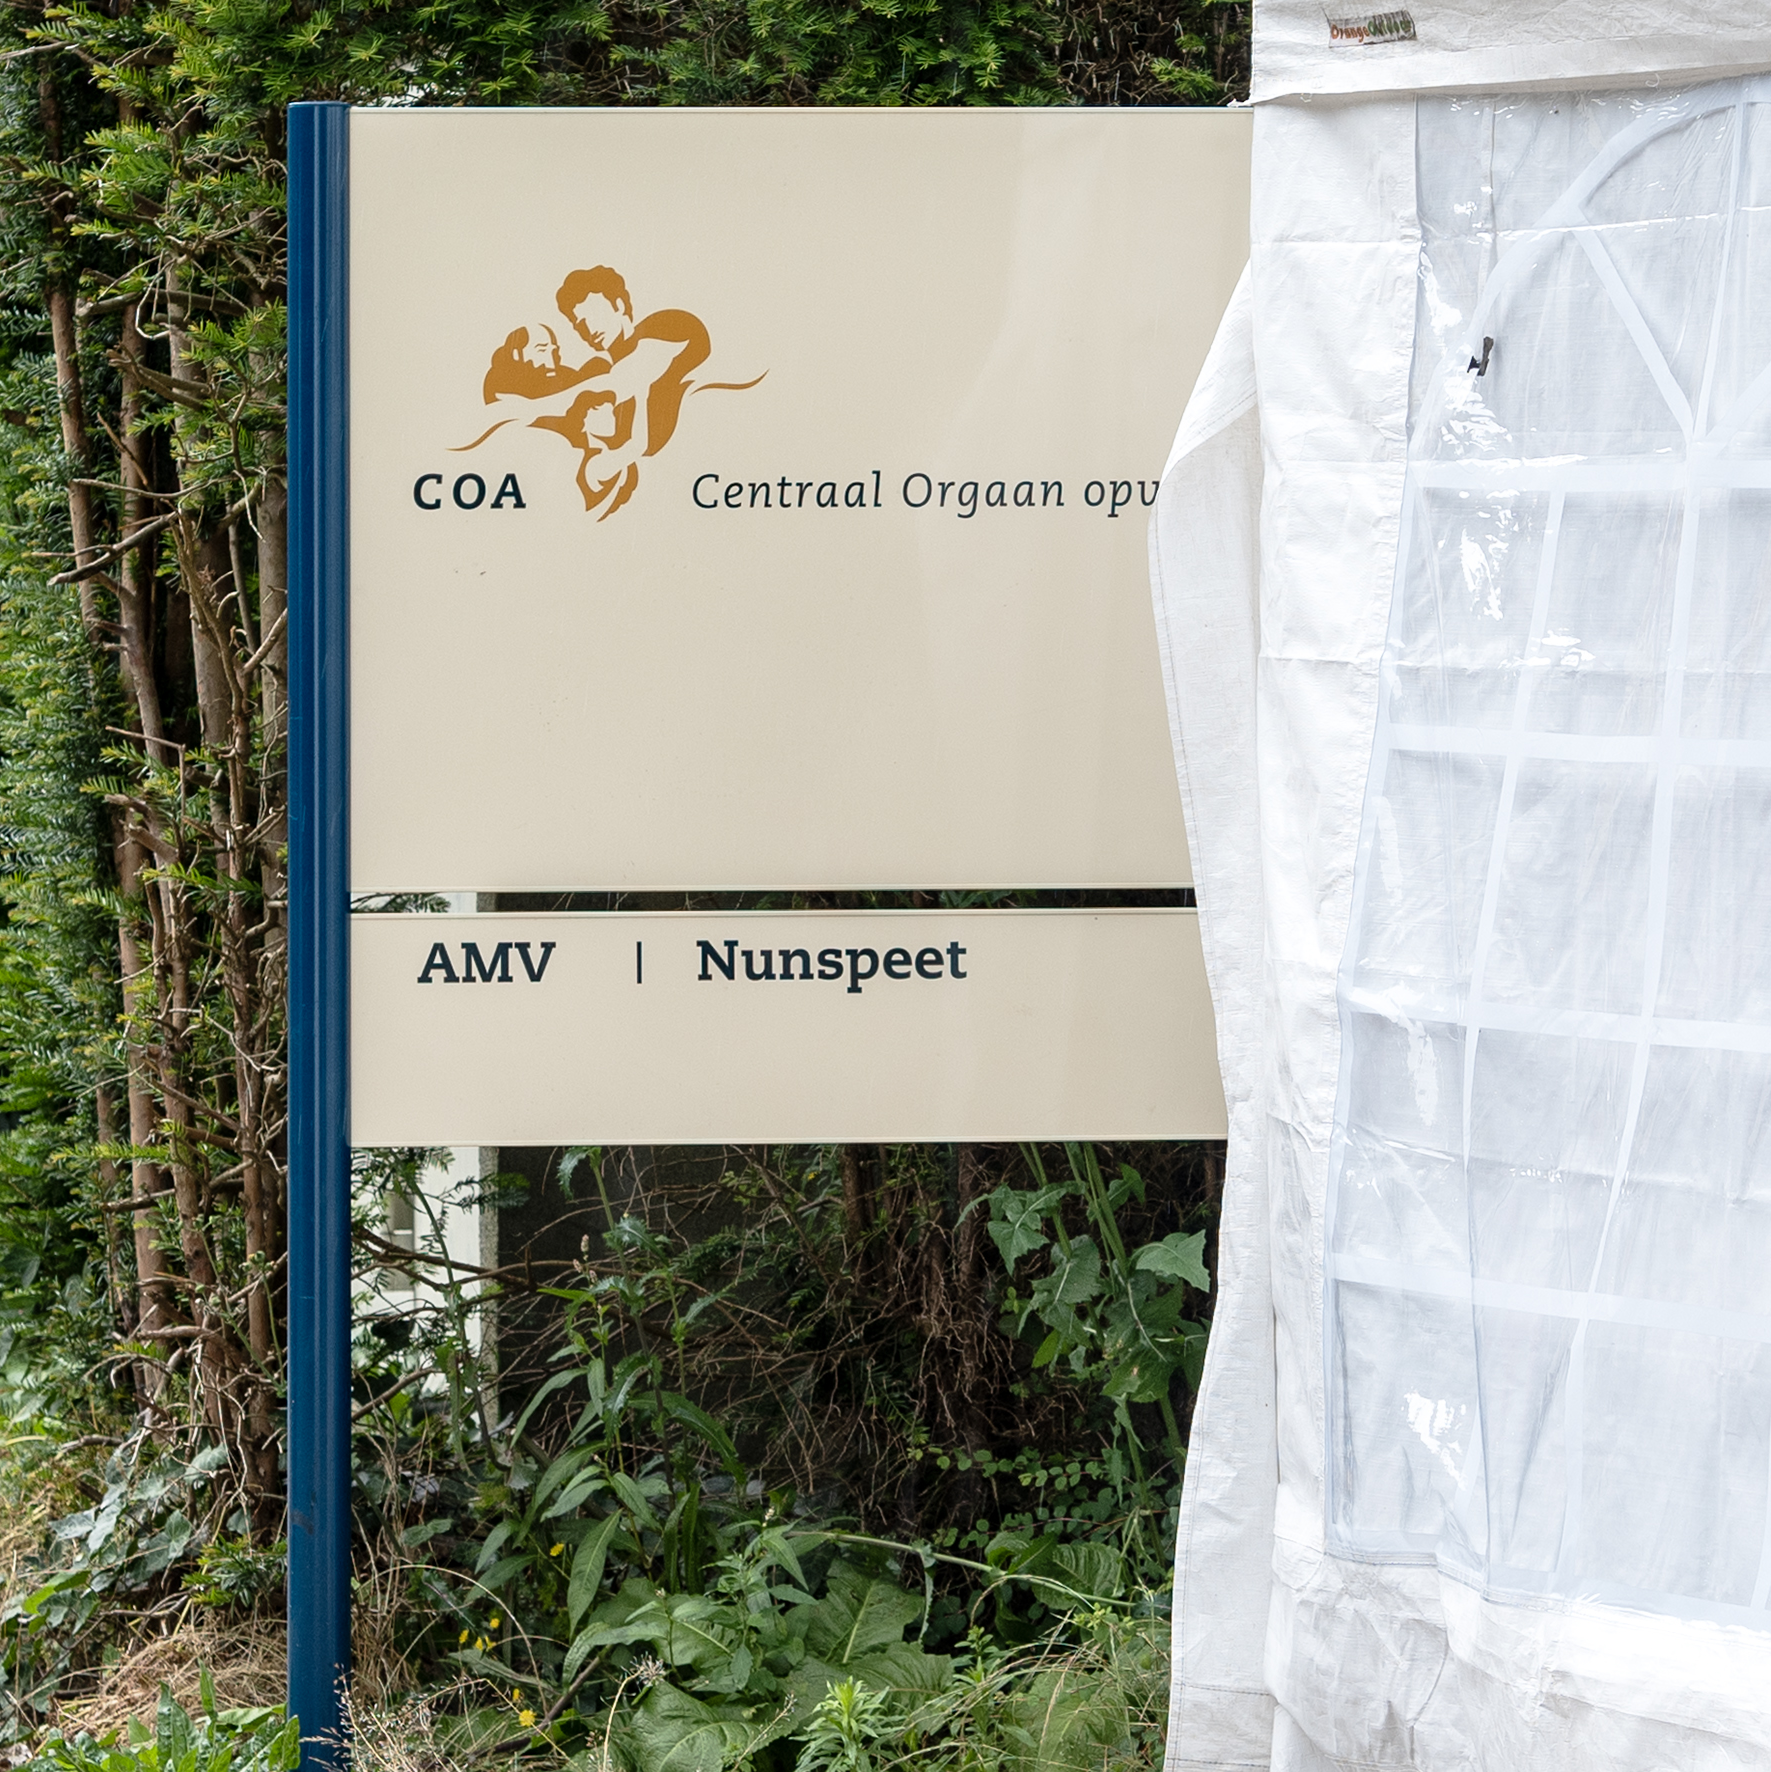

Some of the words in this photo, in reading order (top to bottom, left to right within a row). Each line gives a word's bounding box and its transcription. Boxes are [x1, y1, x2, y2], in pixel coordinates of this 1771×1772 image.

[413, 473, 527, 511] COA
[692, 471, 882, 509] Centraal
[902, 473, 1065, 519] Orgaan
[417, 941, 557, 984] AMV
[696, 939, 967, 994] Nunspeet
